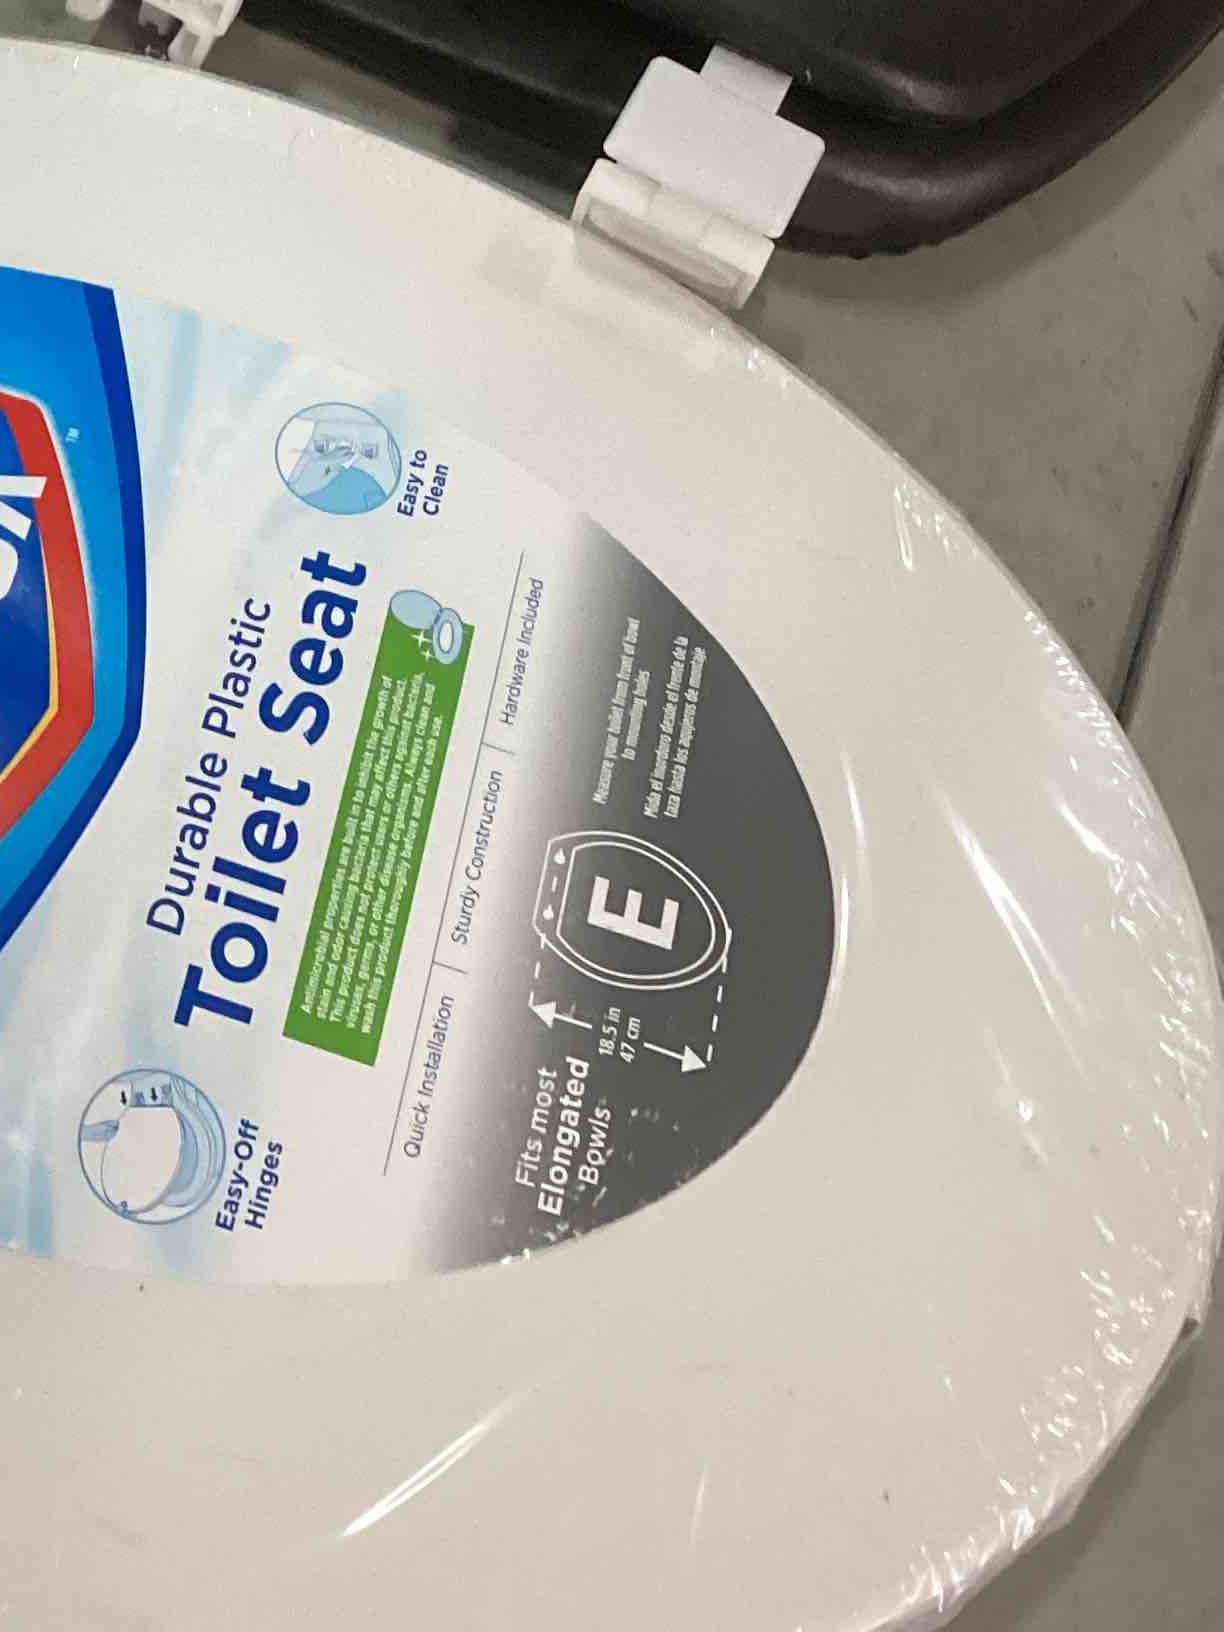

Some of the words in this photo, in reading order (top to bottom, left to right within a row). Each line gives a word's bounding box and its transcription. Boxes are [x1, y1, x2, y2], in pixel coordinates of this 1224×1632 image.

[409, 449, 427, 468] to
[396, 472, 423, 516] Easy
[422, 463, 448, 515] Clean
[499, 648, 529, 725] Hardware
[515, 577, 543, 645] Included
[380, 674, 393, 689] of
[422, 681, 436, 706] and
[371, 688, 389, 730] growth
[414, 704, 431, 736] clean
[365, 730, 380, 750] the
[380, 724, 396, 746] this
[146, 753, 227, 937] Durable
[203, 598, 272, 740] Plastic
[373, 746, 391, 782] affect
[403, 736, 424, 777] Always
[422, 737, 438, 766] each
[174, 765, 310, 1030] Toilet
[259, 550, 367, 745] Seat
[351, 788, 365, 803] to
[367, 782, 383, 808] may
[384, 761, 402, 800] others
[415, 765, 431, 795] after
[350, 802, 361, 817] in
[359, 807, 375, 833] that
[381, 799, 392, 815] or
[410, 794, 425, 819] and
[398, 818, 419, 859] before
[464, 770, 502, 880] Construction
[338, 845, 351, 867] are
[362, 846, 381, 893] protect
[378, 841, 399, 887] disease
[322, 866, 346, 930] properties
[357, 891, 371, 915] not
[370, 886, 387, 921] other
[588, 876, 679, 951] E
[348, 914, 366, 945] does
[367, 921, 379, 937] or
[450, 885, 479, 944] Sturdy
[330, 930, 345, 961] odor
[374, 925, 394, 976] product
[299, 929, 330, 1014] Antimicrobial
[324, 960, 339, 987] and
[337, 945, 358, 997] product
[366, 975, 382, 1001] this
[328, 997, 346, 1022] This
[360, 1001, 377, 1033] wash
[603, 1006, 621, 1023] in
[597, 1023, 618, 1055] 18.5
[626, 1016, 641, 1040] cm
[618, 1040, 636, 1063] 47
[403, 1102, 429, 1158] Quick
[417, 995, 454, 1097] Installation
[514, 1138, 542, 1187] Fits
[530, 1066, 557, 1133] most
[537, 1055, 589, 1215] Elongated
[577, 1106, 610, 1184] Bowls
[214, 1118, 258, 1231] Easy-Off
[244, 1141, 282, 1229] Hinges
